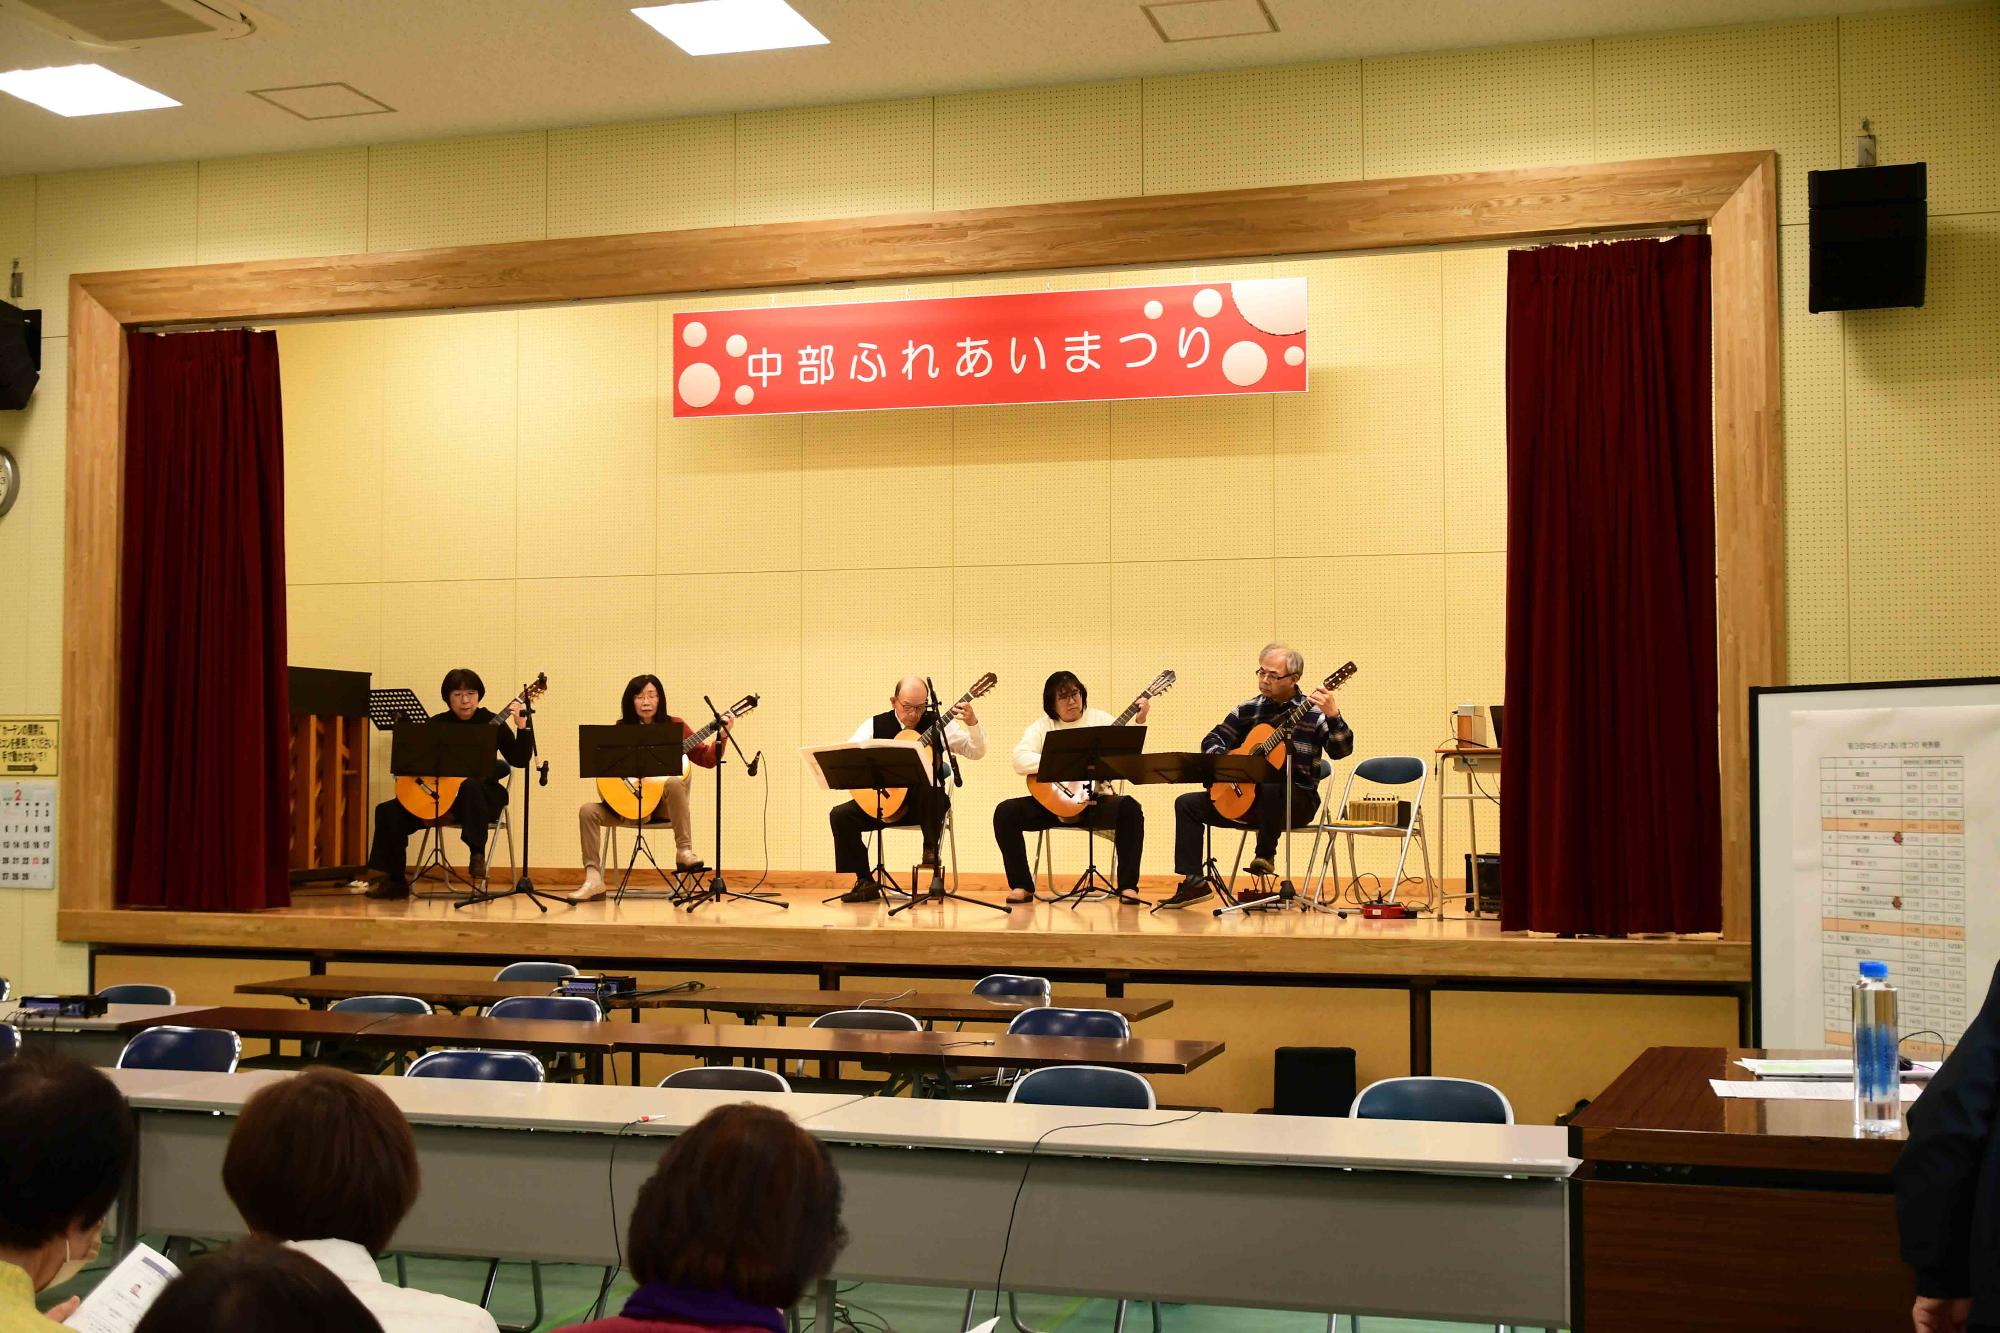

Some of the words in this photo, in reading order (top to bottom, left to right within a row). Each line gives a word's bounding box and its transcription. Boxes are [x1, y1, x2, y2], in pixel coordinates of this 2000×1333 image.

[747, 326, 1211, 388] 中部ふれあいまつり
[15, 788, 22, 801] 2
